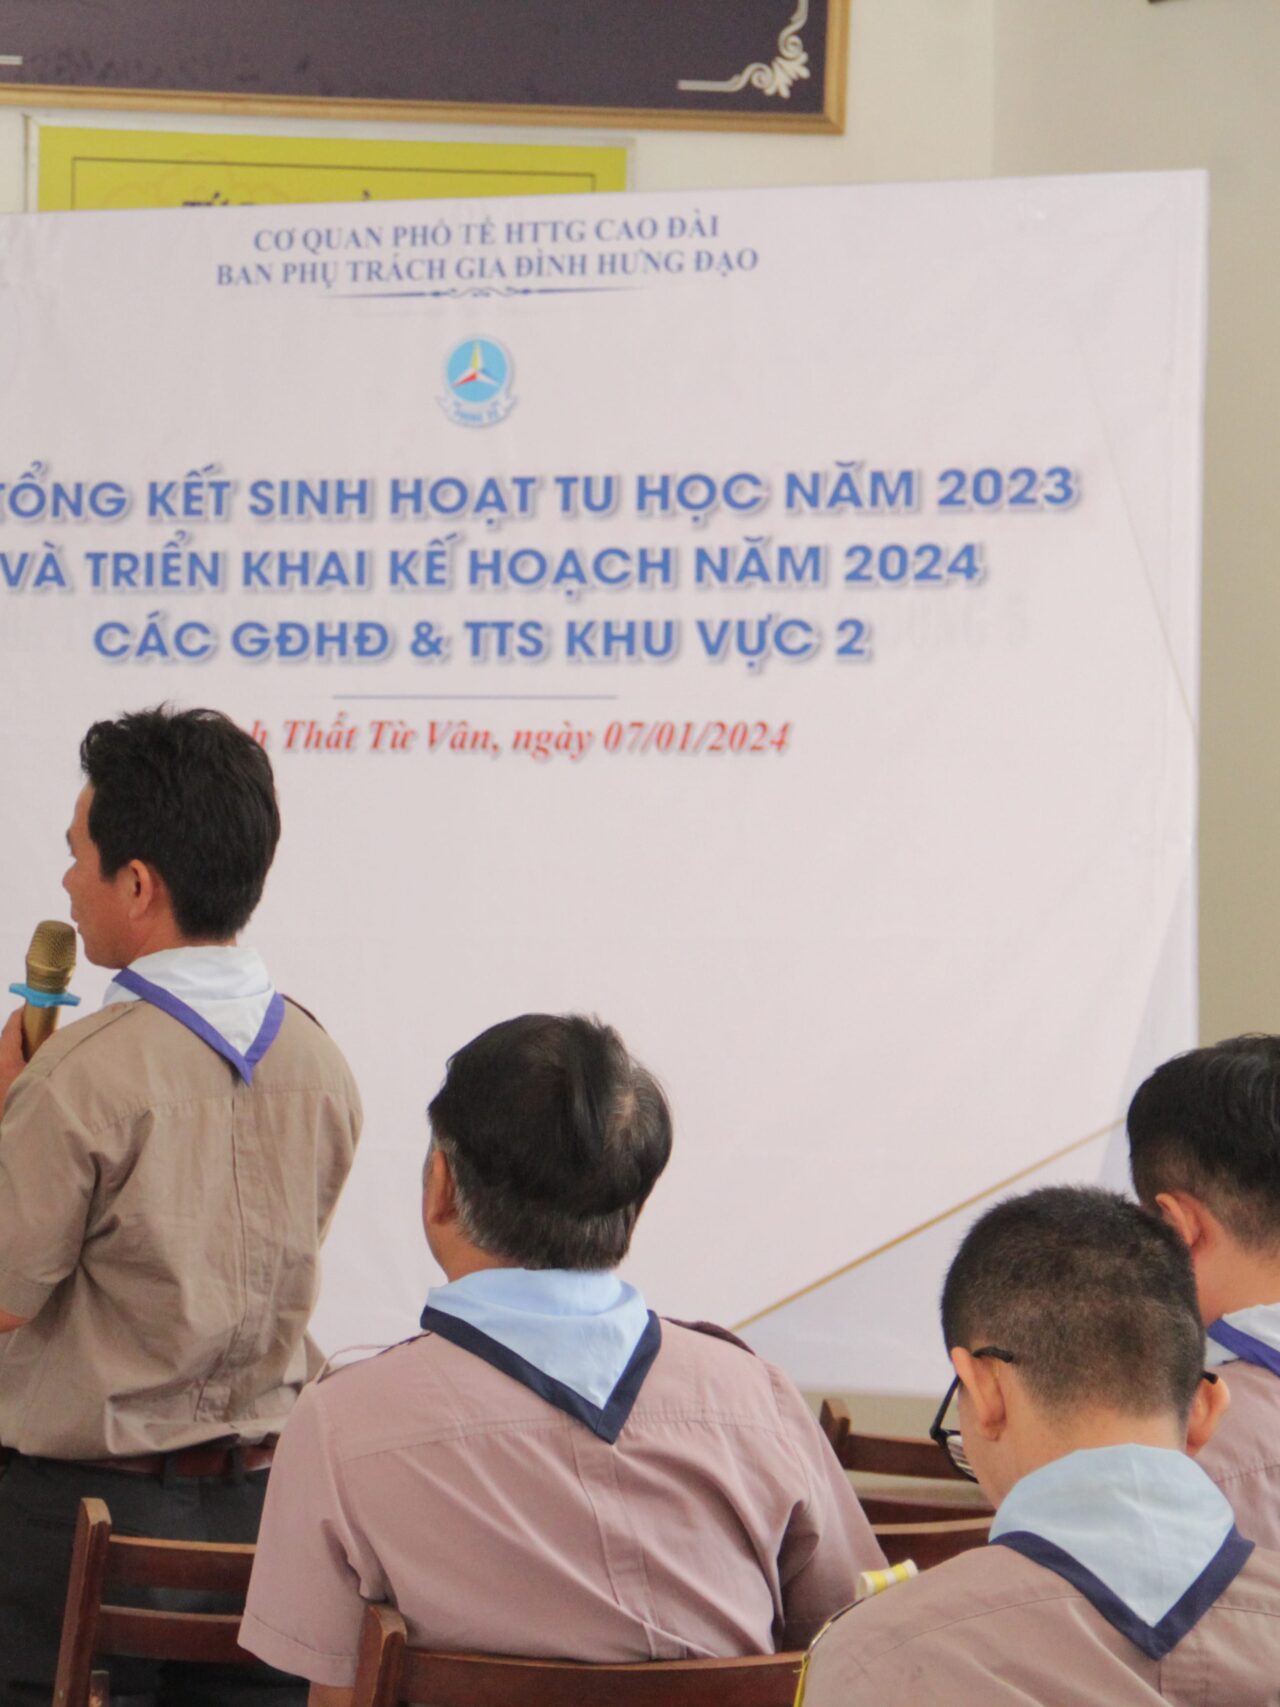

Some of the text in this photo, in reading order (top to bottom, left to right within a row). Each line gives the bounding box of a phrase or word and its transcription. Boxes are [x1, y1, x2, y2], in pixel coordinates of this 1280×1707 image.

[254, 229, 297, 251] CƠ
[302, 227, 381, 255] QUAN
[506, 221, 585, 244] HTTG
[594, 219, 658, 240] CAO
[668, 210, 719, 239] ĐÀI
[218, 264, 273, 285] BAN
[283, 262, 337, 289] PHỤ
[349, 254, 445, 282] TRÁCH
[455, 257, 506, 278] GIA
[515, 250, 586, 277] ĐÌNH
[694, 250, 758, 276] ĐẠO
[149, 465, 231, 516] KẾT
[250, 480, 367, 516] SINH
[391, 478, 535, 525] HOẠT
[556, 477, 612, 512] TU
[637, 474, 760, 523] HỌC
[786, 461, 912, 508] NĂM
[939, 467, 1072, 506] 2023
[0, 530, 976, 596] VÀ TRIỂN KHAI KẾ HOẠCH NĂM 2024
[95, 611, 864, 668] CÁC GĐHĐ & TTS KHU VỰC 2
[429, 721, 500, 756] Vân,
[513, 720, 592, 760] ngày
[604, 721, 790, 751] 07/01/2024
